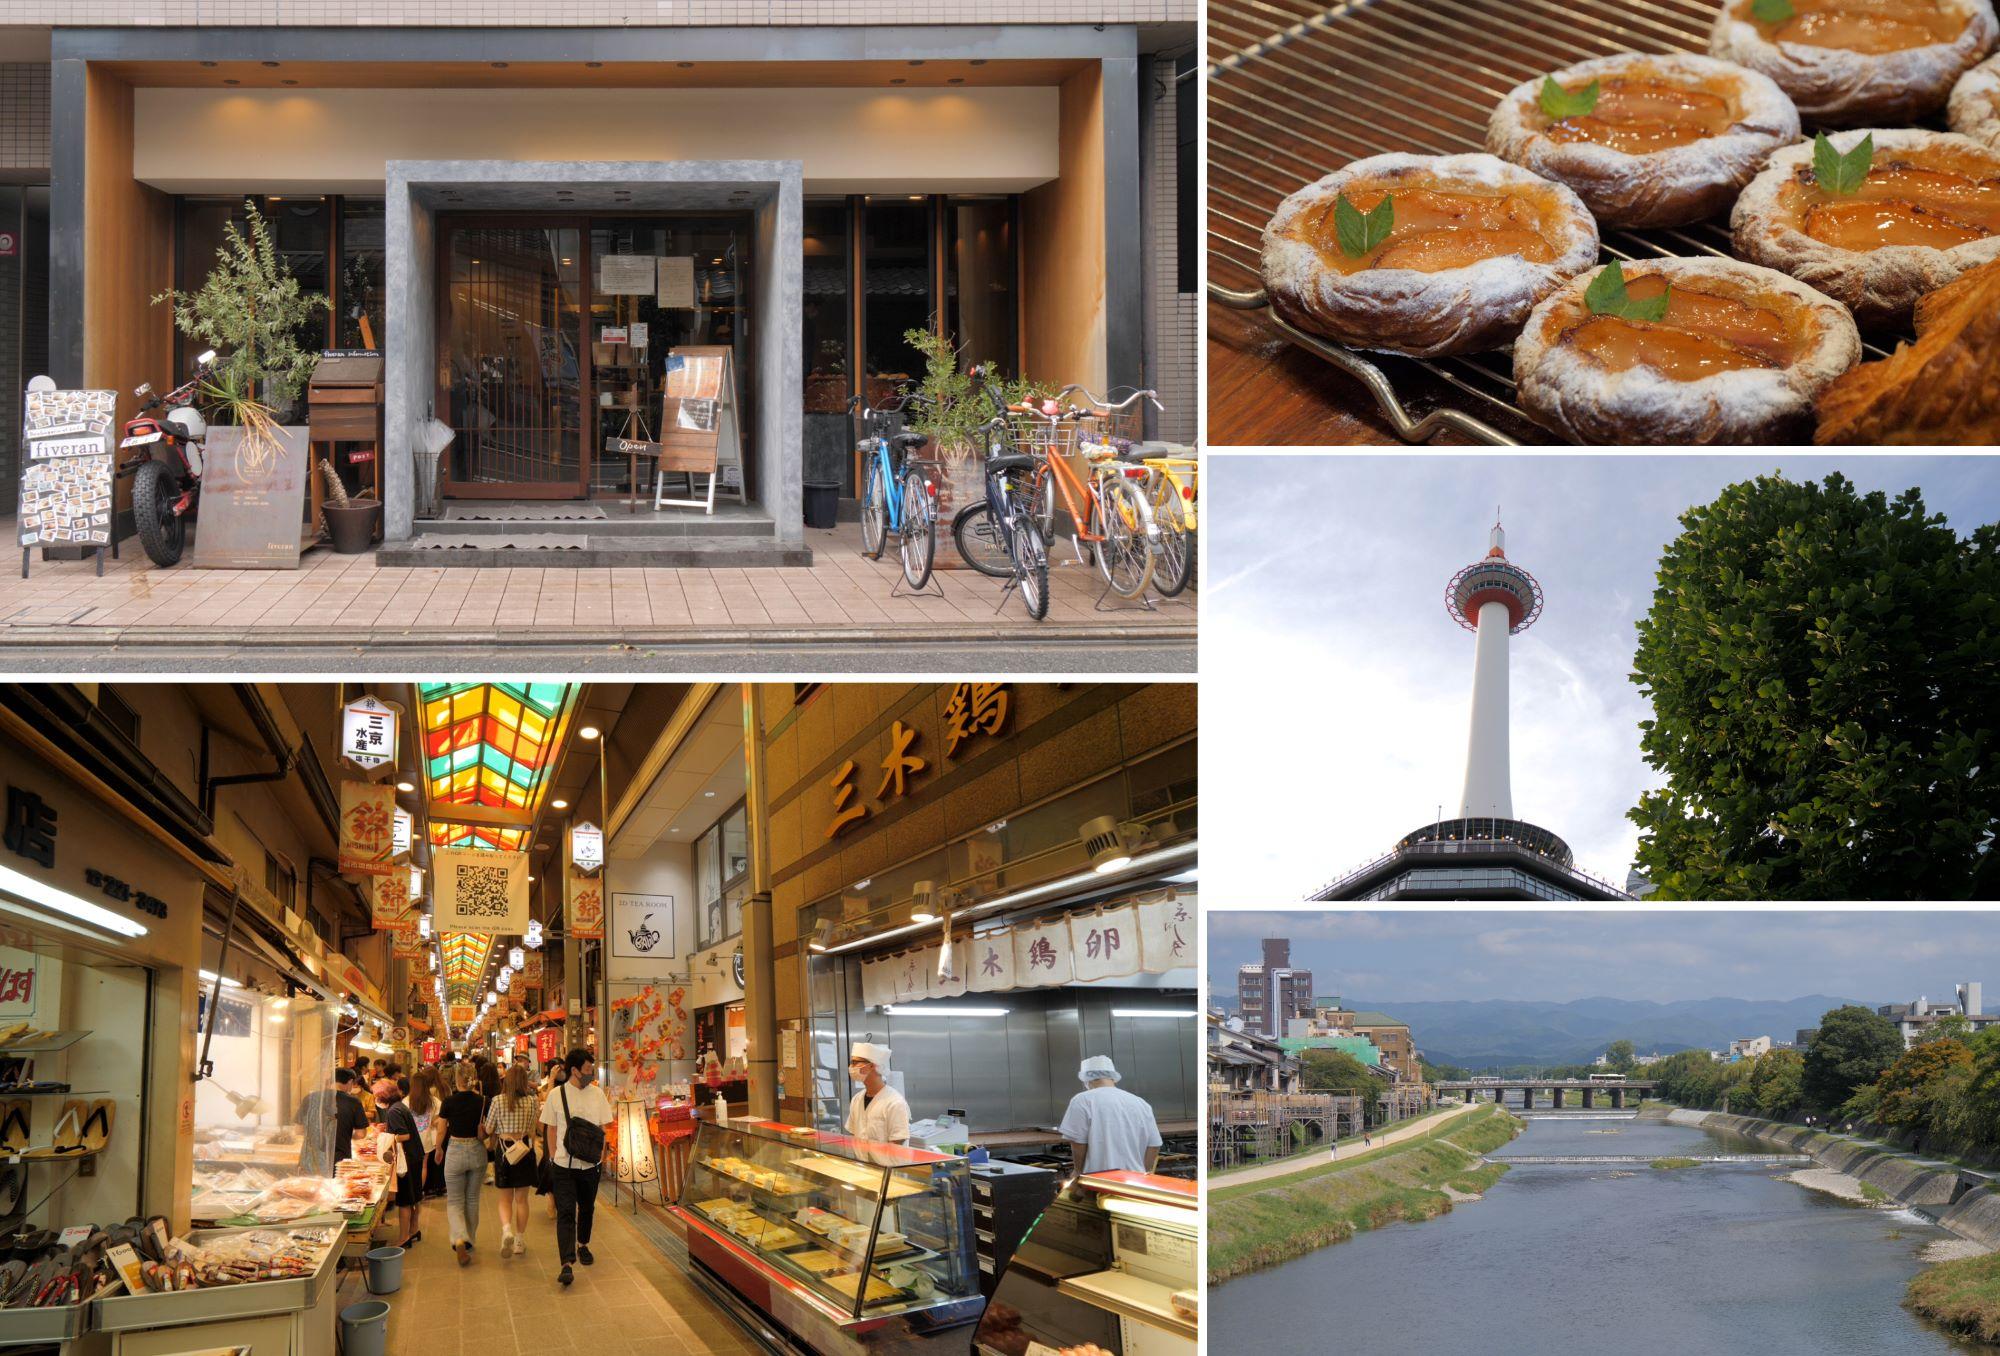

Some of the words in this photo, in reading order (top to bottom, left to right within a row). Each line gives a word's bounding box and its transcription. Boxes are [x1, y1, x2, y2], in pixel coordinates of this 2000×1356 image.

[36, 443, 99, 457] fiveran
[619, 440, 647, 451] Open
[369, 715, 383, 745] 三京
[356, 728, 367, 751] 水産
